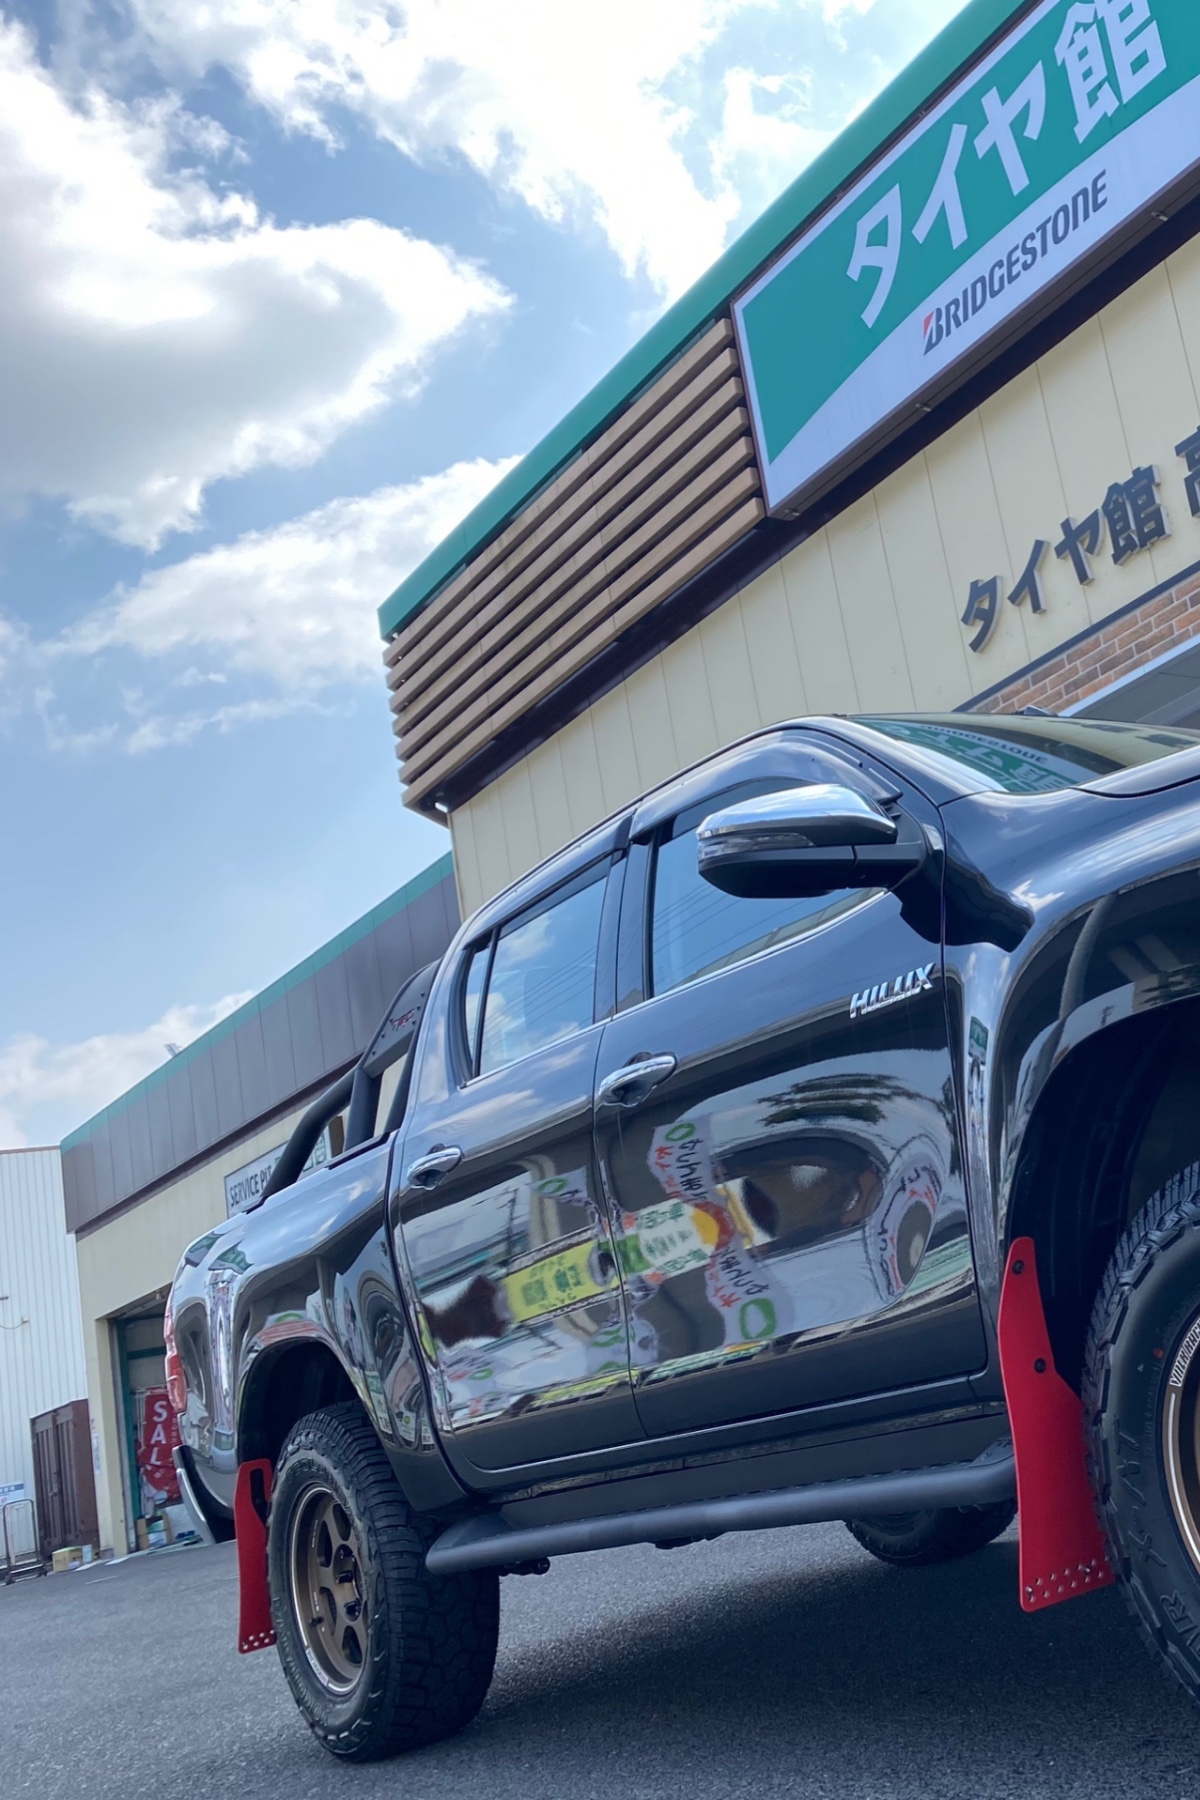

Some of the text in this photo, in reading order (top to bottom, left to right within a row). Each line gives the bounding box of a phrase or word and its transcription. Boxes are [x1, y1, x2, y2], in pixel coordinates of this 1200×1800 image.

[846, 0, 1167, 328] タイヤ館
[922, 169, 1109, 356] BRIDGESTONE
[960, 463, 1171, 653] タイヤ館
[849, 961, 936, 1019] HILUX
[229, 1173, 260, 1208] SERVICE
[1168, 1348, 1190, 1388] VOLK
[150, 1400, 168, 1480] SAL
